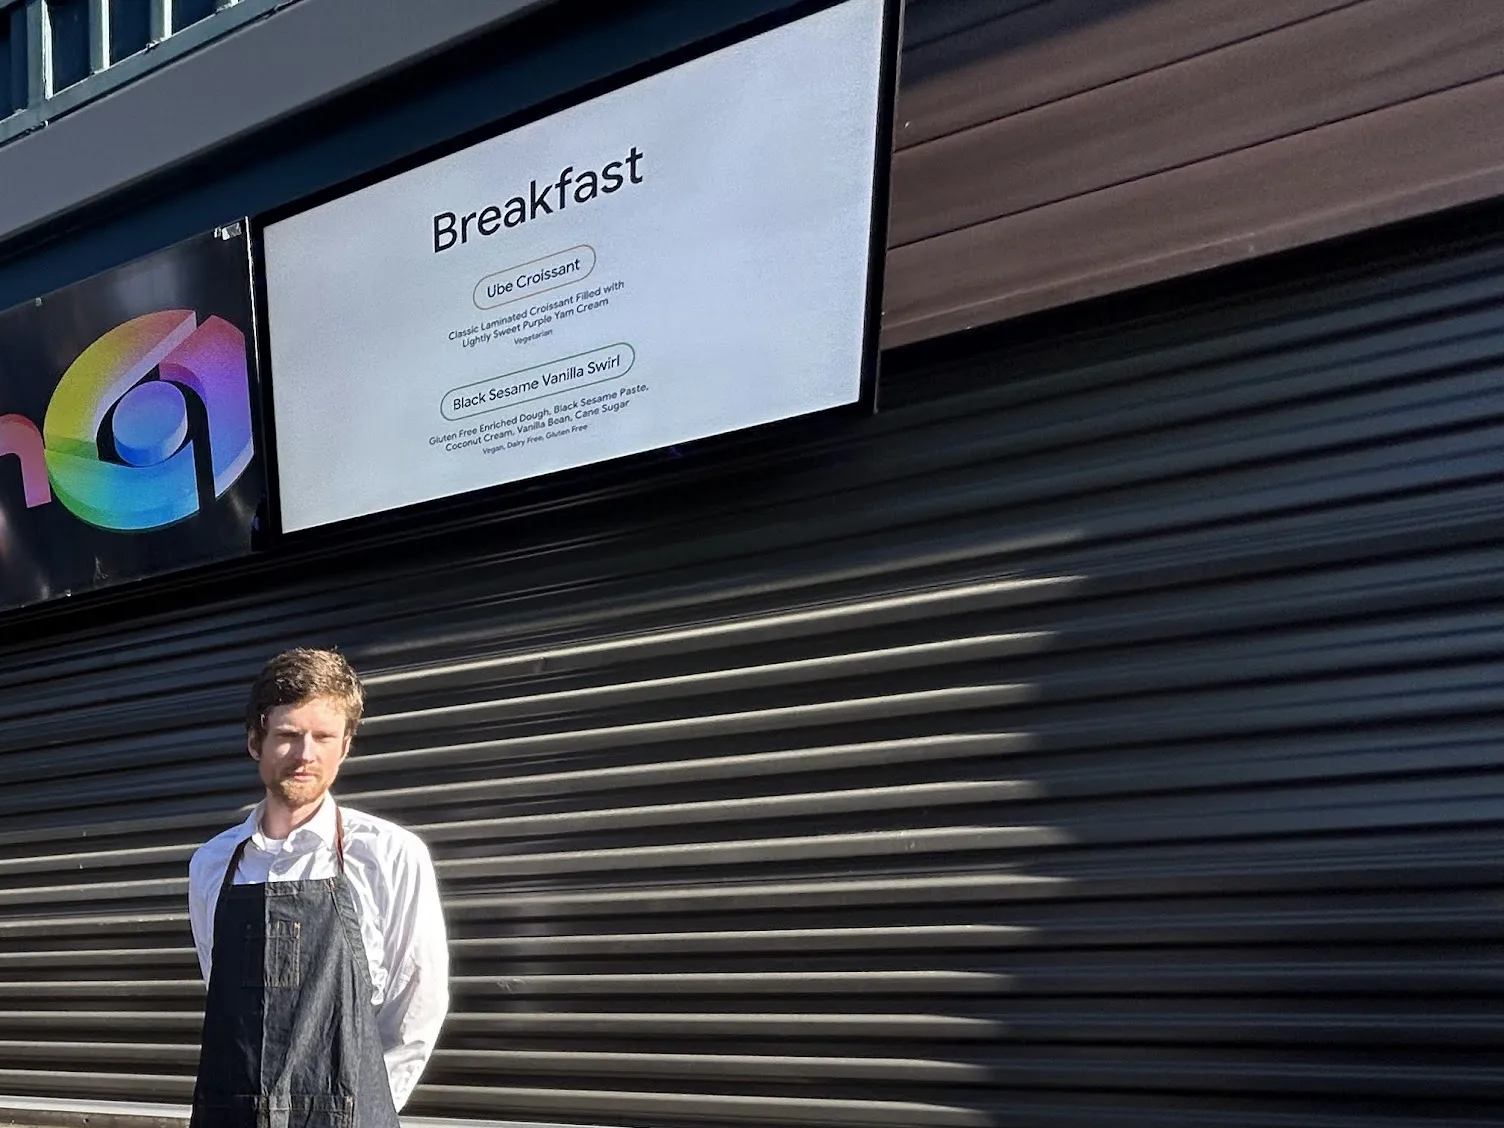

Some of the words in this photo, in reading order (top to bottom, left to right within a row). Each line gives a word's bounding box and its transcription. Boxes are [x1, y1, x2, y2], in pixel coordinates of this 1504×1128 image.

[433, 147, 644, 253] Breakfast
[487, 282, 513, 298] Ube
[516, 259, 580, 288] Croissant
[448, 325, 479, 340] Classic
[481, 309, 528, 331] Laminated
[529, 296, 574, 316] Croissant
[576, 287, 601, 302] Filled
[603, 280, 625, 294] with
[462, 333, 492, 348] Lightly
[493, 324, 521, 339] Sweet
[522, 315, 553, 330] Purple
[554, 309, 575, 320] Yam
[576, 298, 609, 313] Cream
[513, 329, 553, 345] Vegetarian
[453, 392, 486, 411] Black
[488, 379, 539, 401] Sesame
[541, 366, 585, 386] Vanilla
[587, 354, 621, 375] Swirl
[428, 432, 457, 445] Gluten
[458, 428, 478, 438] Free
[479, 416, 518, 433] Enriched
[553, 401, 578, 414] Black
[580, 391, 618, 407] Sesame
[445, 437, 482, 451] Coconut
[516, 420, 546, 434] Vanilla
[574, 407, 600, 420] Cane
[601, 400, 631, 413] Sugar
[506, 439, 526, 449] Dairy
[545, 428, 570, 440] Gluten
[571, 424, 589, 434] Free
